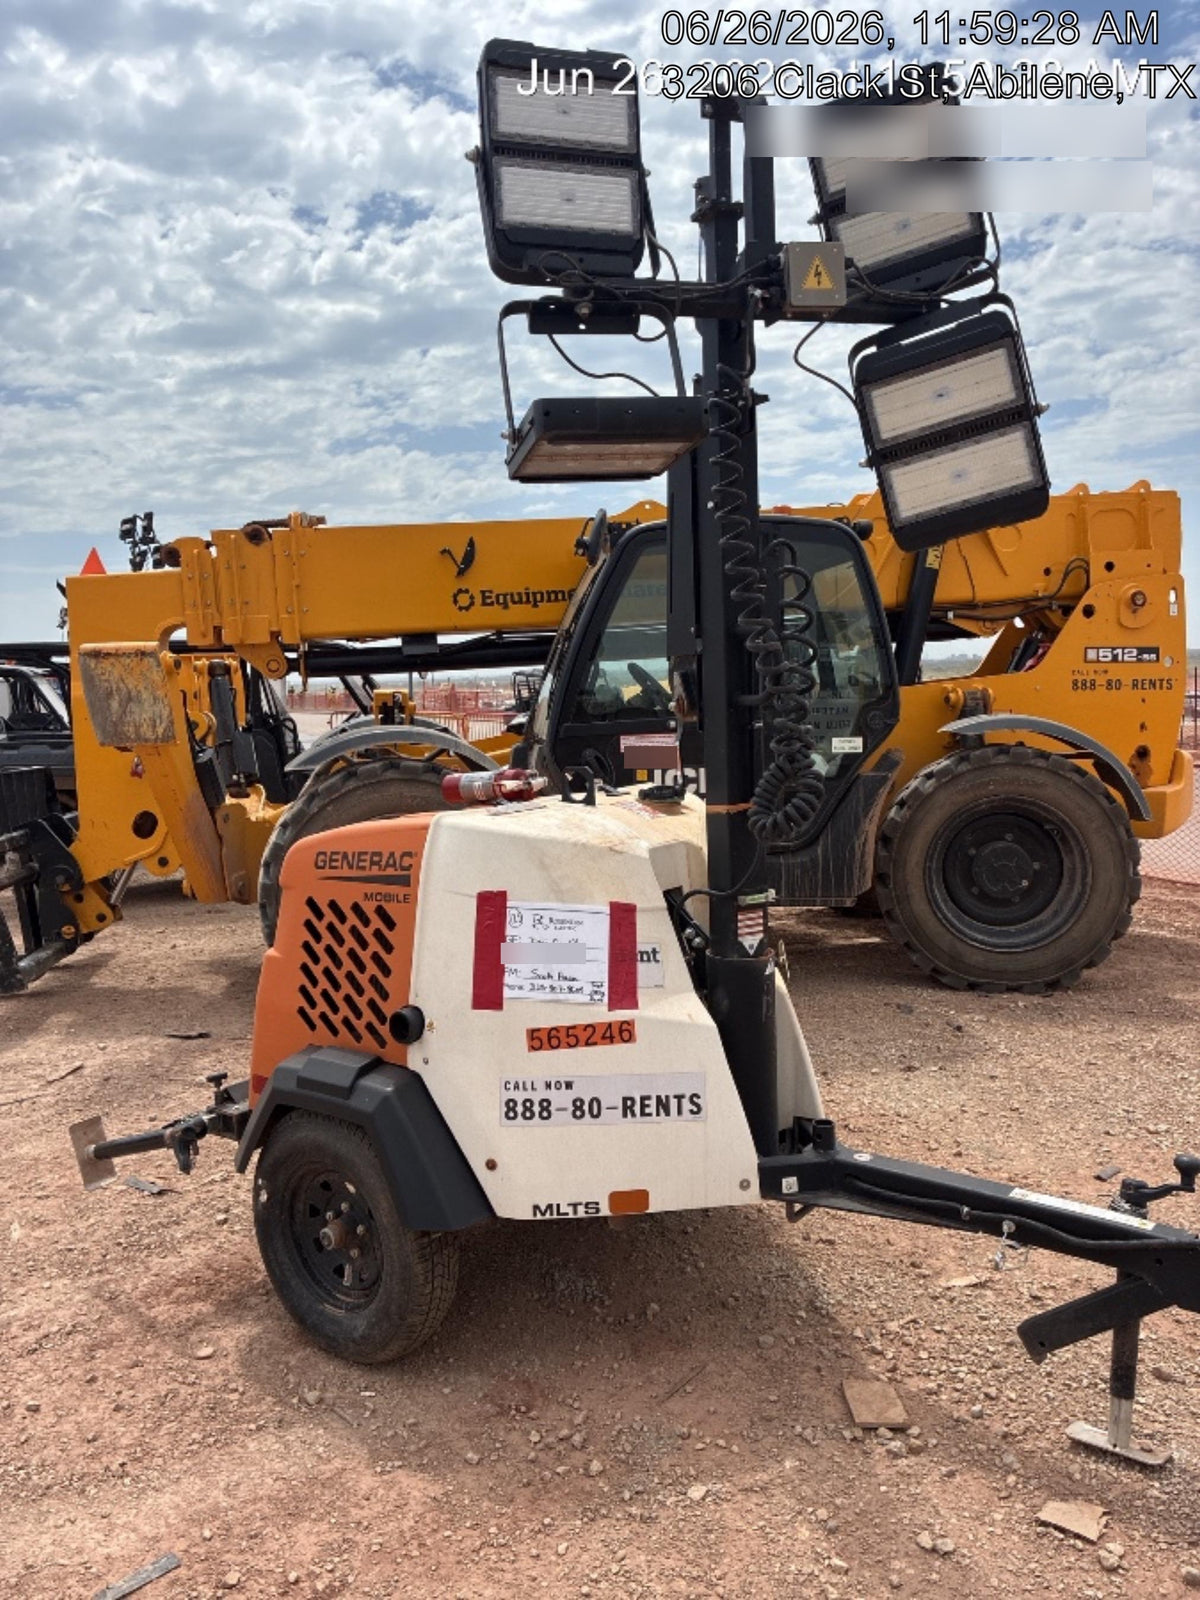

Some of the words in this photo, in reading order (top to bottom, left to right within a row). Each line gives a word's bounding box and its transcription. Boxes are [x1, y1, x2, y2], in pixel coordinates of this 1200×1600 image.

[1071, 677, 1174, 691] 888-80-RENTS
[314, 850, 414, 872] GENERAC
[363, 891, 411, 904] MOBILE
[530, 1020, 633, 1051] 565246
[503, 1080, 538, 1092] CALL
[544, 1079, 575, 1091] NOW
[503, 1092, 703, 1121] 888-80-RENTS
[532, 1201, 601, 1218] MLTS
